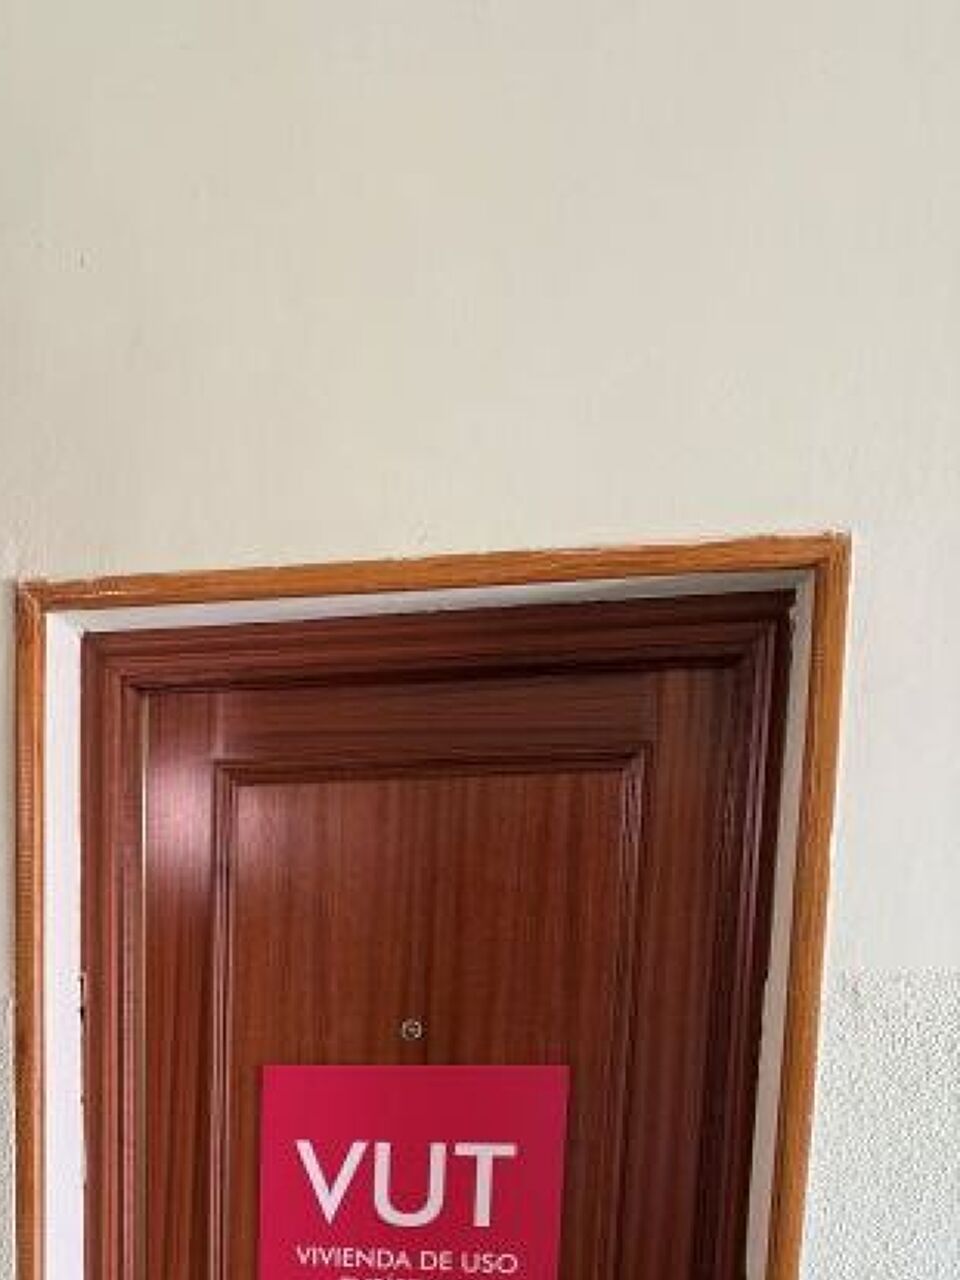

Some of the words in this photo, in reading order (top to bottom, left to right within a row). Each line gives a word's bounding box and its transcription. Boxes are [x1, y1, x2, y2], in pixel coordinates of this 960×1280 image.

[296, 1139, 518, 1228] VUT
[296, 1246, 410, 1269] VIVIENDA
[420, 1250, 453, 1271] DE
[460, 1252, 519, 1274] USO
